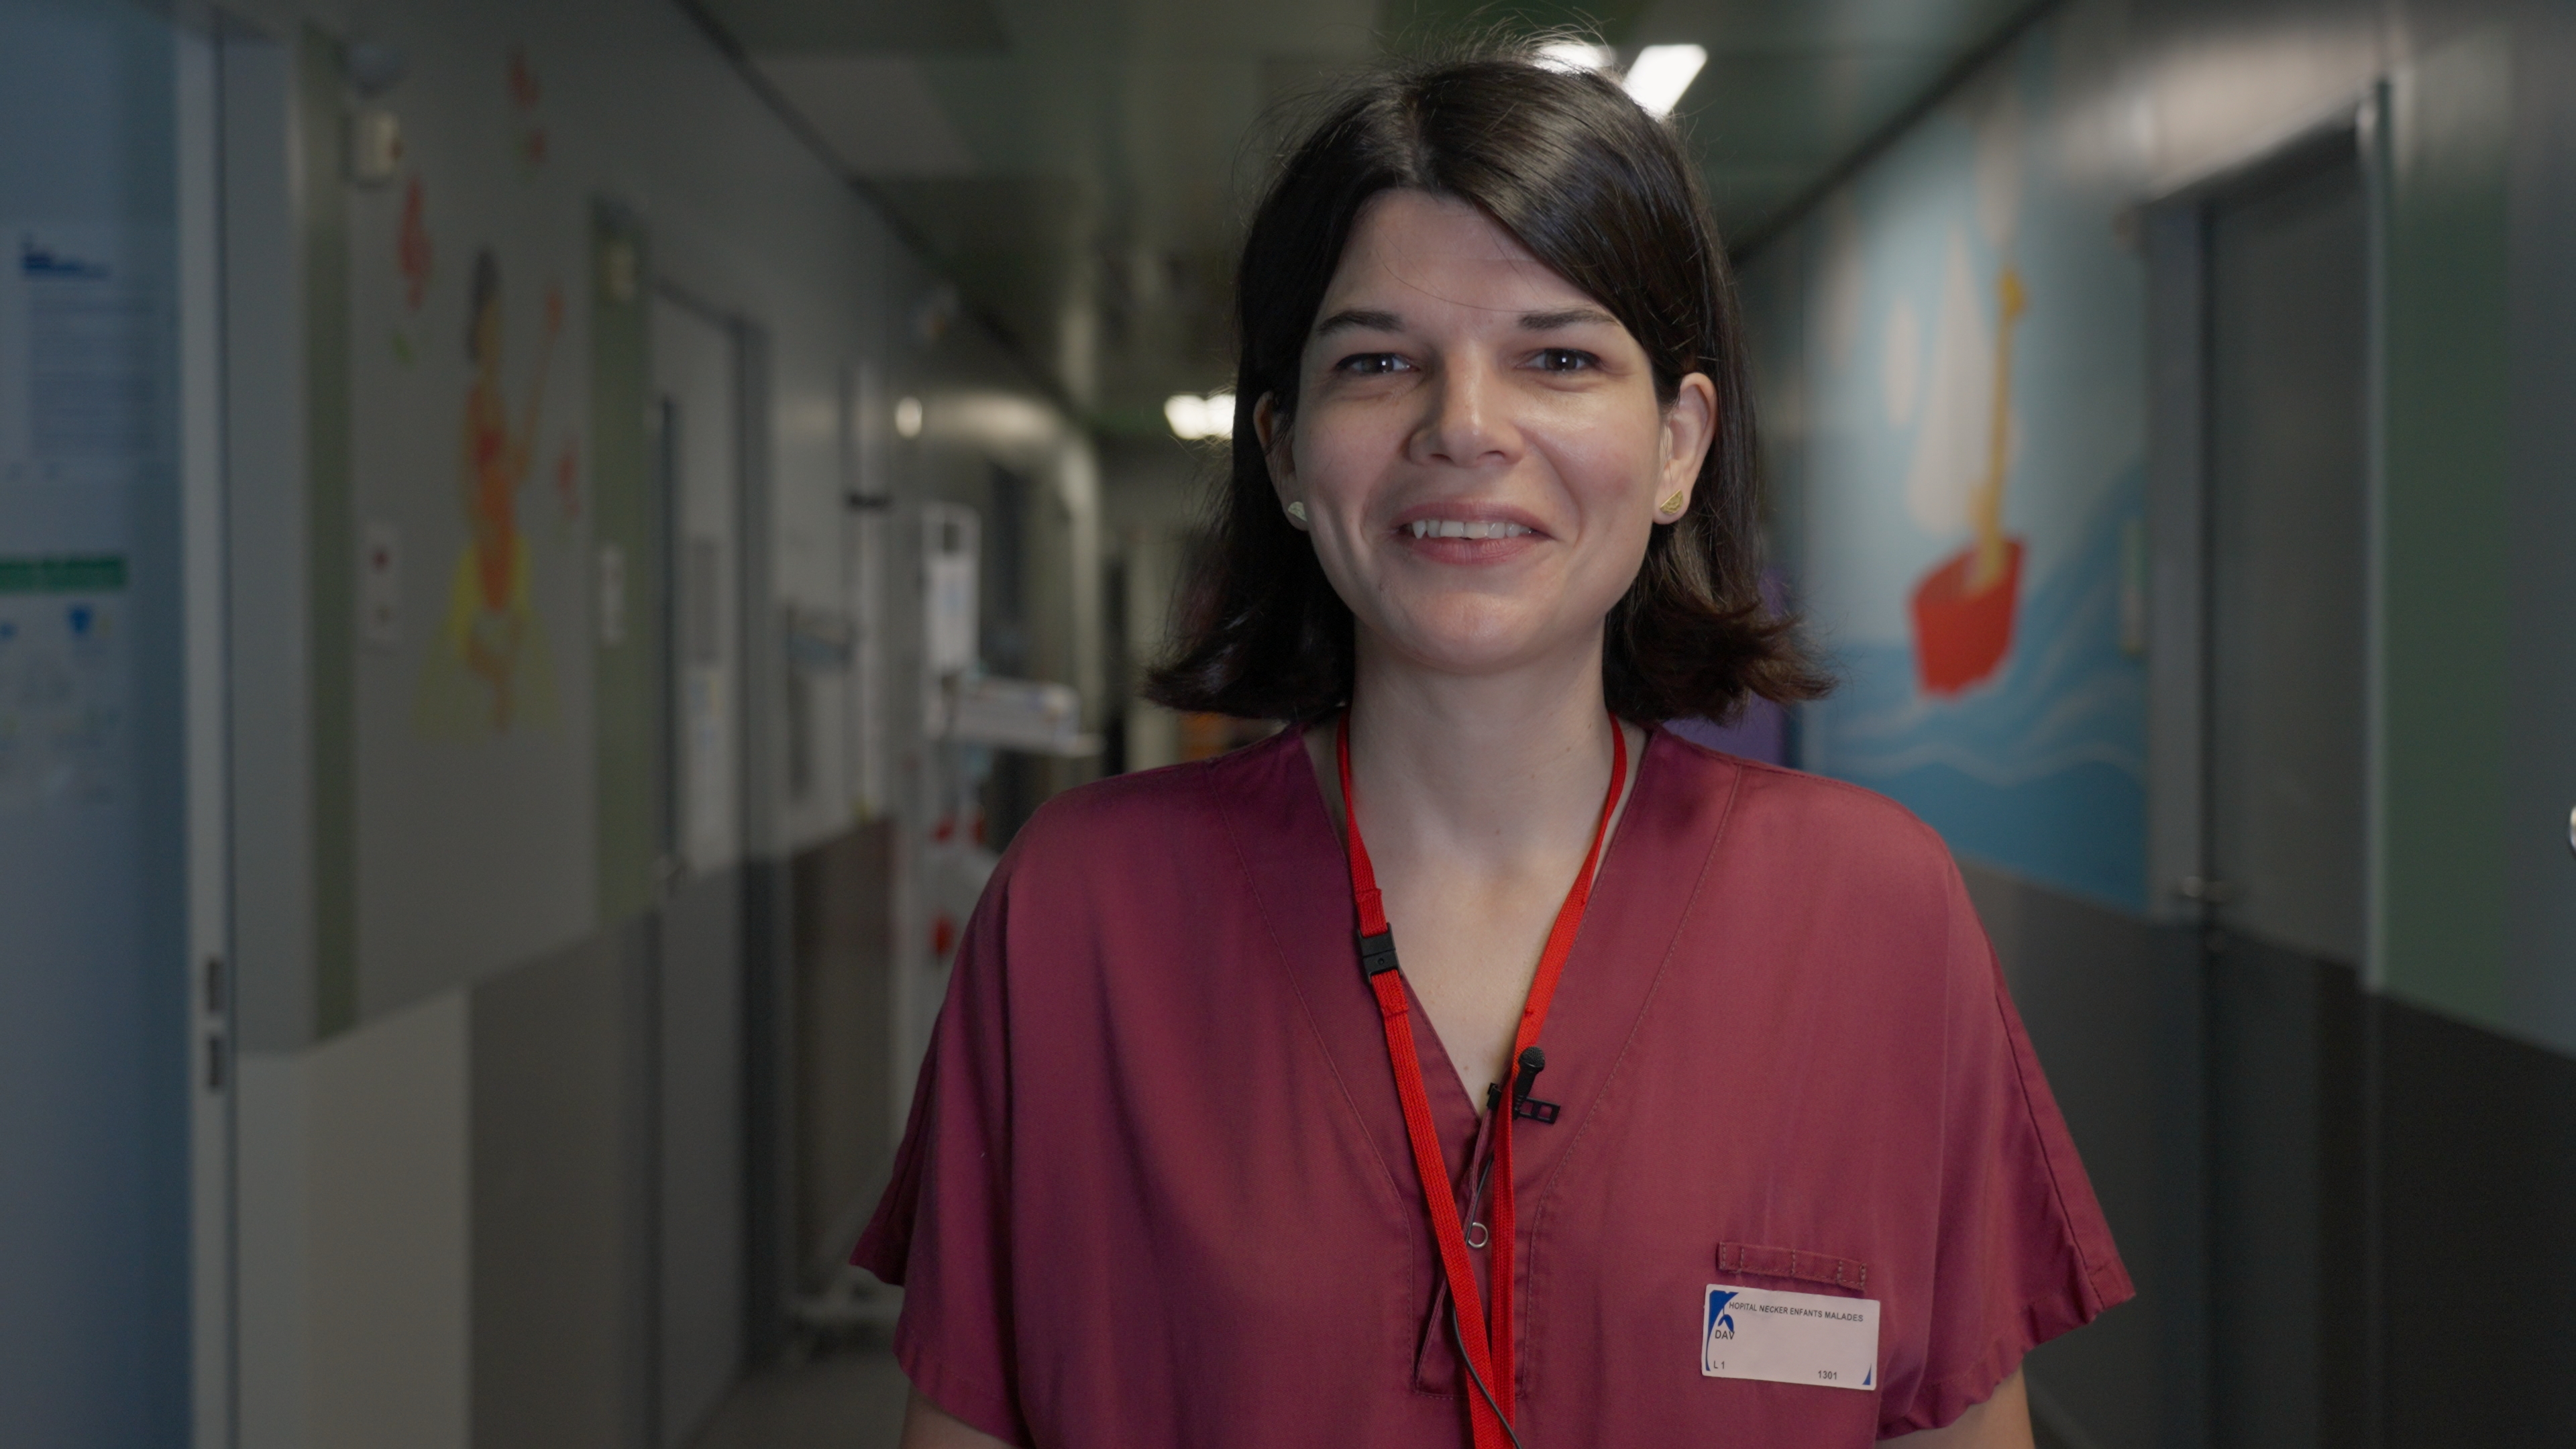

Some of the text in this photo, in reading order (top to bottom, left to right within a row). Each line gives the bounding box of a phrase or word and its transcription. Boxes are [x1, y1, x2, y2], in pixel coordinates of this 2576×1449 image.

[1729, 1301, 1864, 1322] HOPITAL NECKER ENFANTS MALADES
[1715, 1330, 1735, 1340] DAV
[1817, 1371, 1837, 1380] 1301
